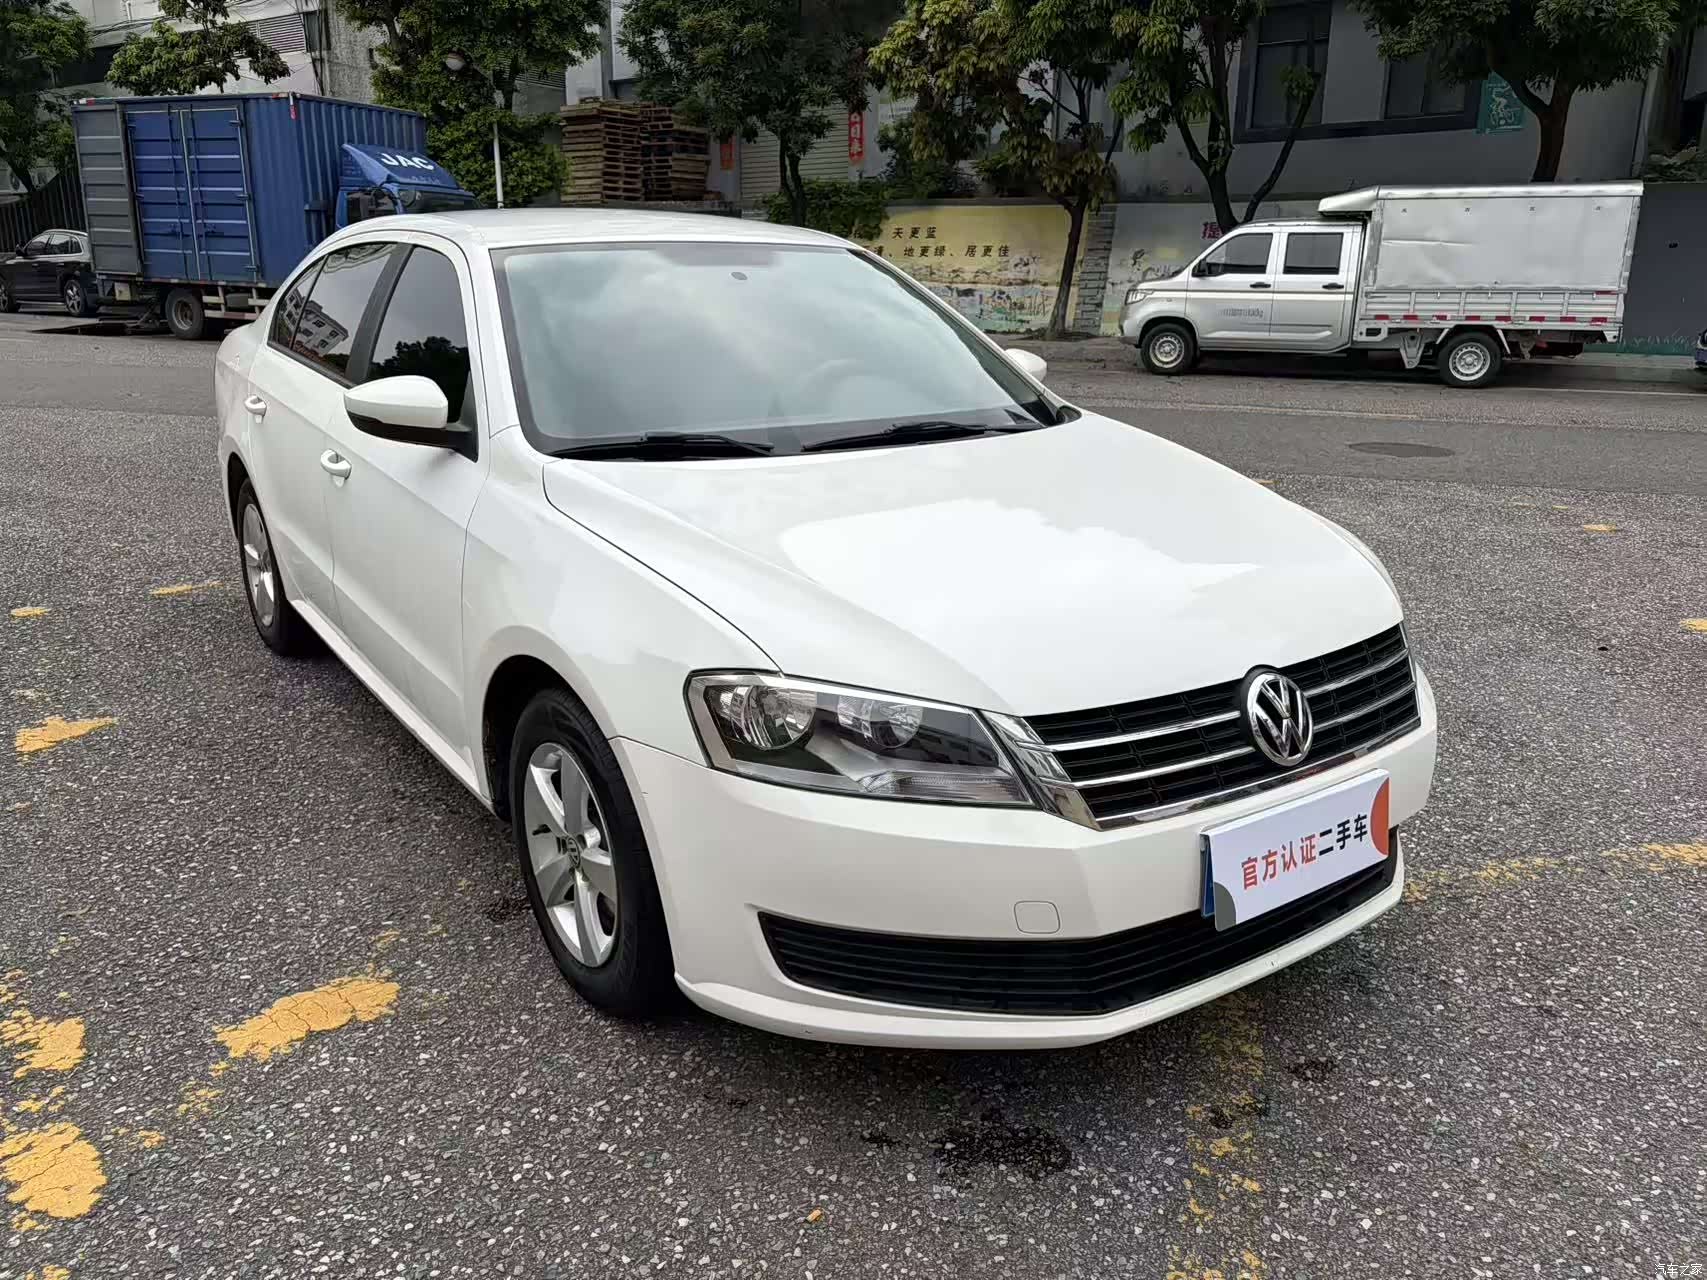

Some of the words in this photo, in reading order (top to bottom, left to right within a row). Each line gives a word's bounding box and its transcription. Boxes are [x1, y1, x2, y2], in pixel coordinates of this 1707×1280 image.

[381, 152, 434, 170] JAC
[892, 226, 937, 239] 天更蓝
[1241, 813, 1368, 891] 官方认证二手车
